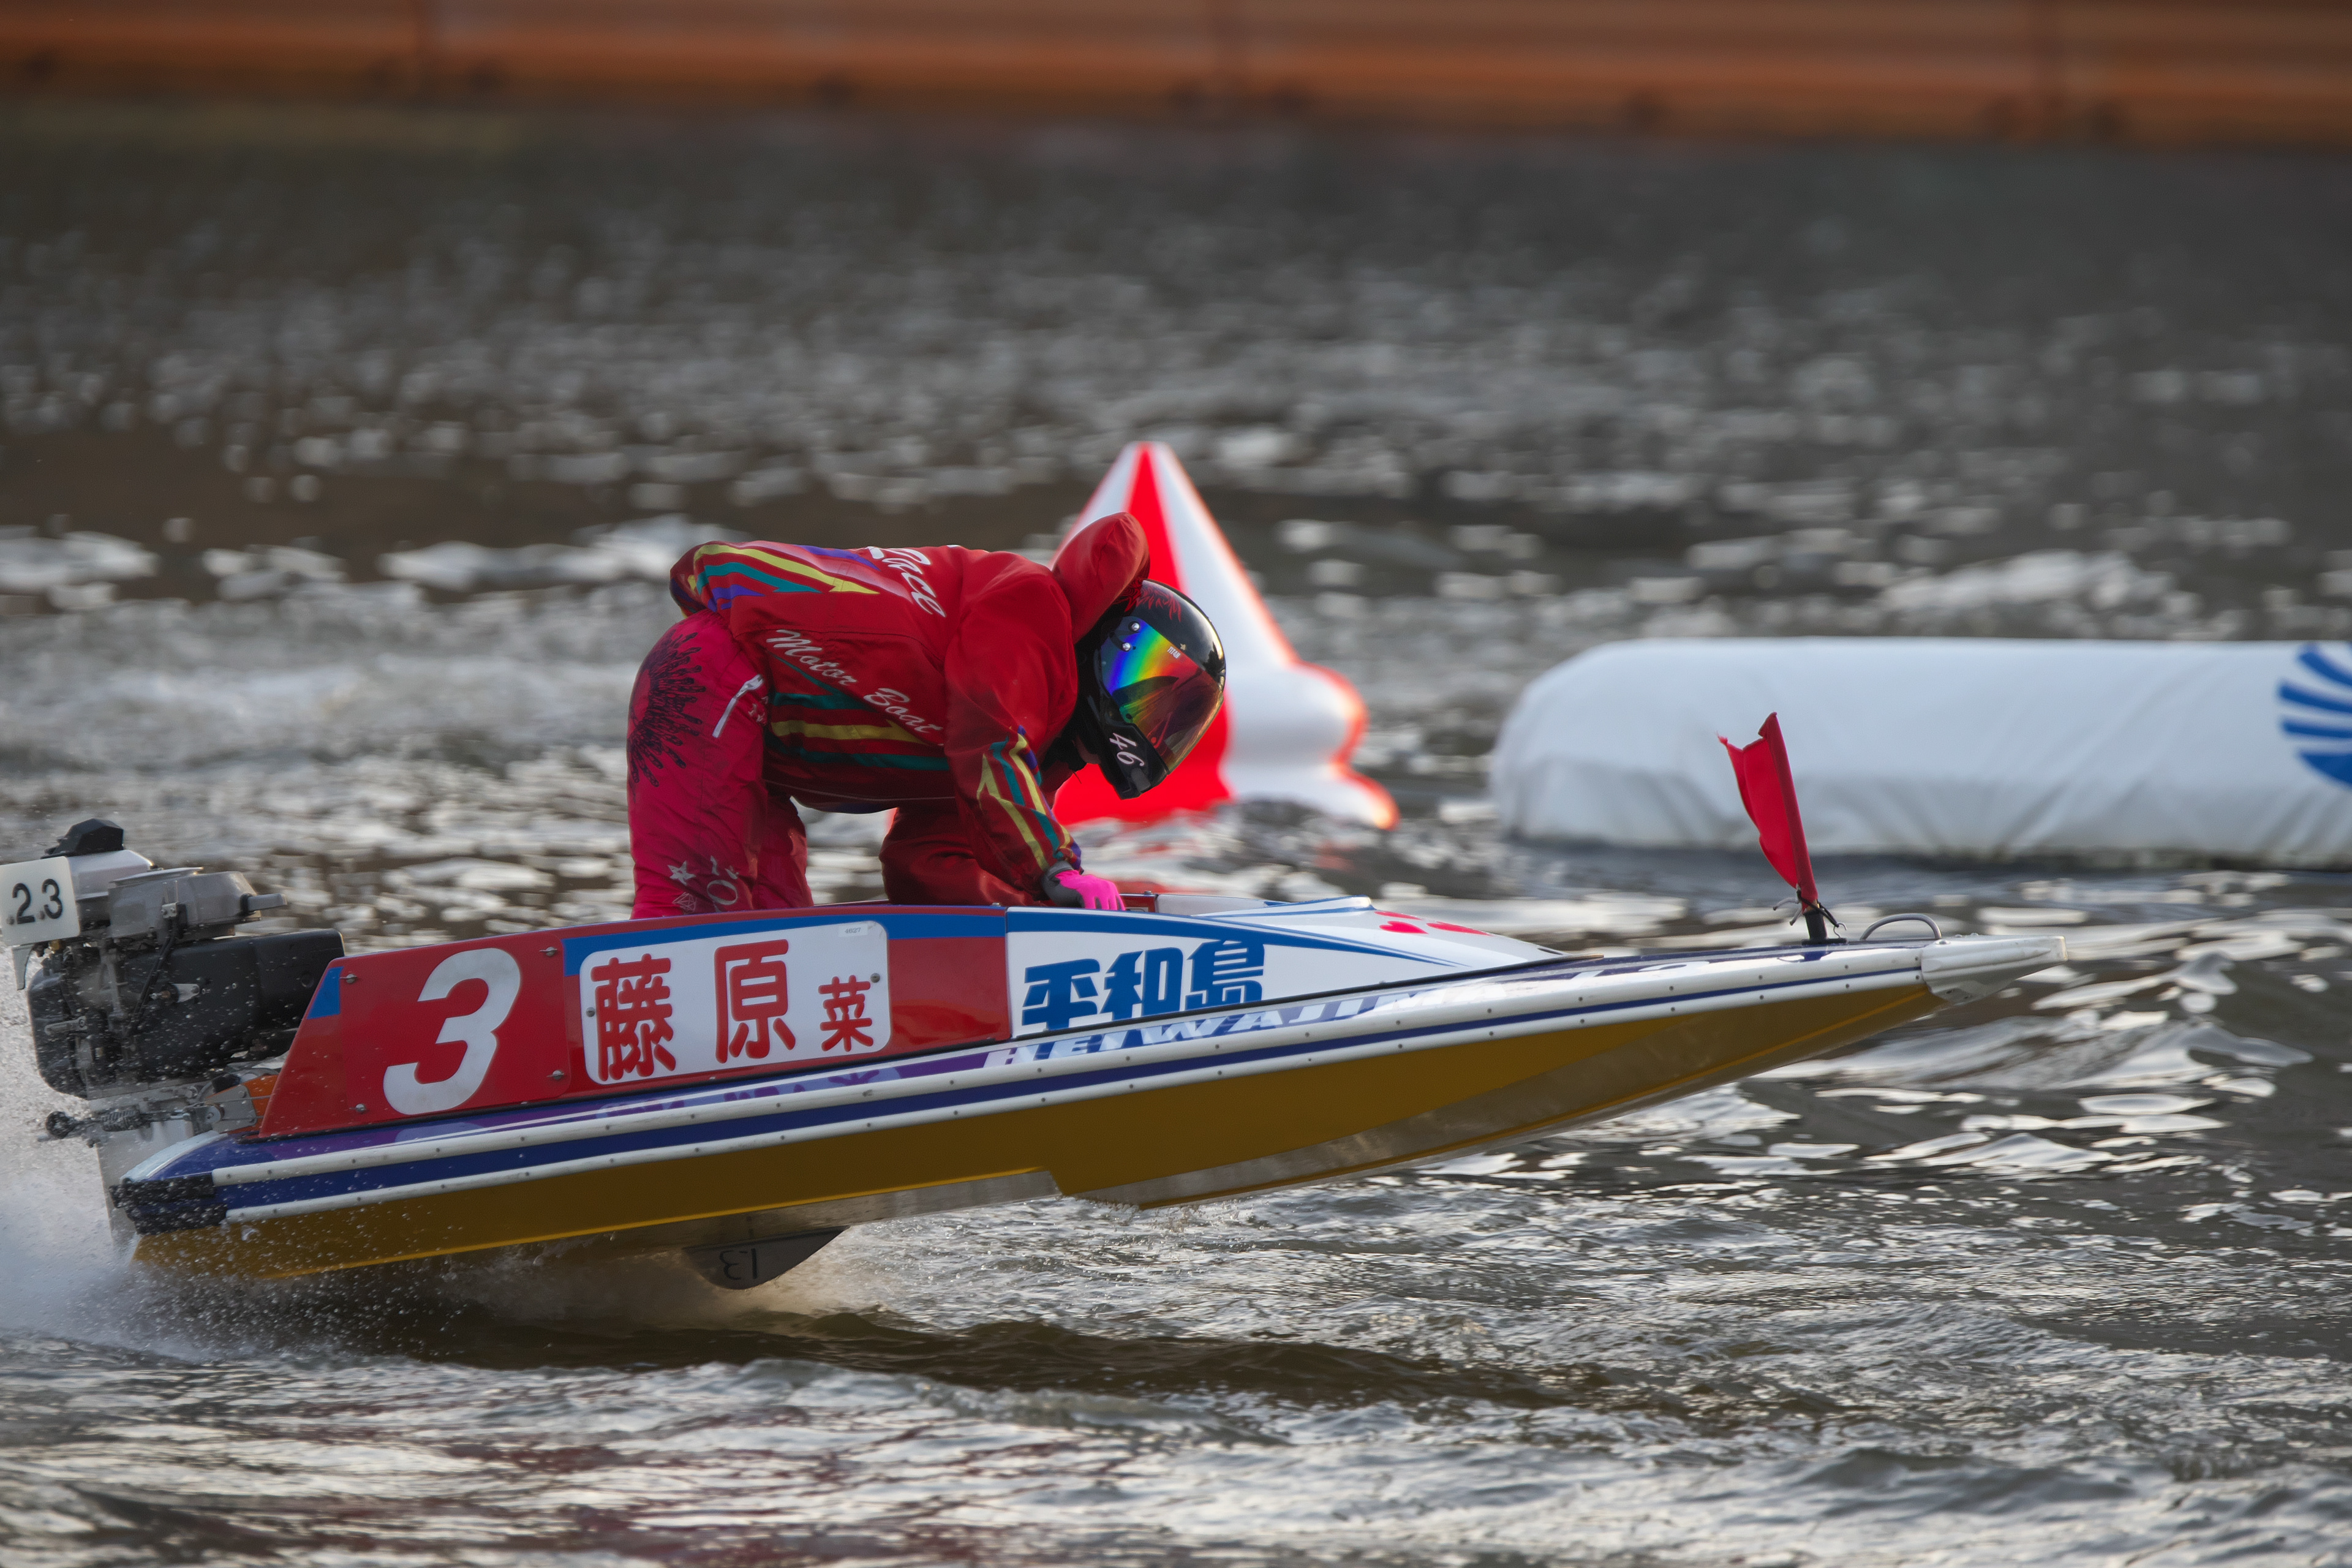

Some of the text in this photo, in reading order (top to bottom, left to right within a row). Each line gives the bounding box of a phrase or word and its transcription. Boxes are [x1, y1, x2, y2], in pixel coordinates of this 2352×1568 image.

[766, 629, 944, 733] Motor Boat
[1109, 733, 1145, 767] 46
[12, 878, 63, 924] 23
[1022, 940, 1265, 1031] 平和島
[383, 948, 521, 1115] 3
